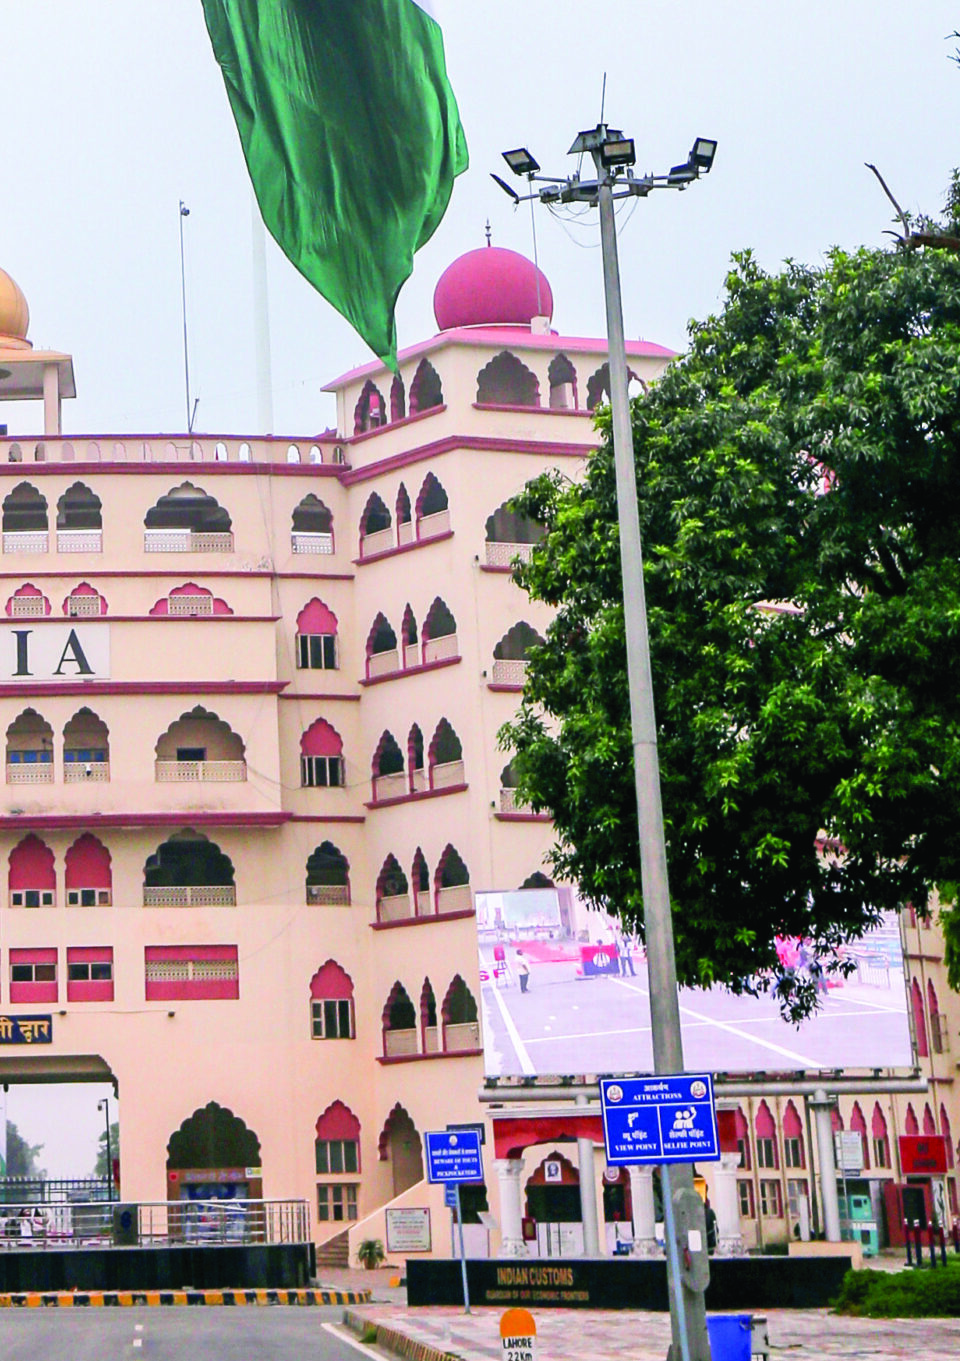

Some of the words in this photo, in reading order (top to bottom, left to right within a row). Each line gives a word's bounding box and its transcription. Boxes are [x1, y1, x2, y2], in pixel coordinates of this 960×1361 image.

[17, 1020, 50, 1043] द्वार
[633, 1092, 683, 1101] ATTRACTIONS
[635, 1143, 657, 1151] POINT
[664, 1141, 688, 1149] SELFIE
[689, 1140, 711, 1148] POINT
[497, 1267, 529, 1286] INDIAN
[529, 1267, 574, 1287] CUSTOMS
[503, 1338, 532, 1349] LAHORE
